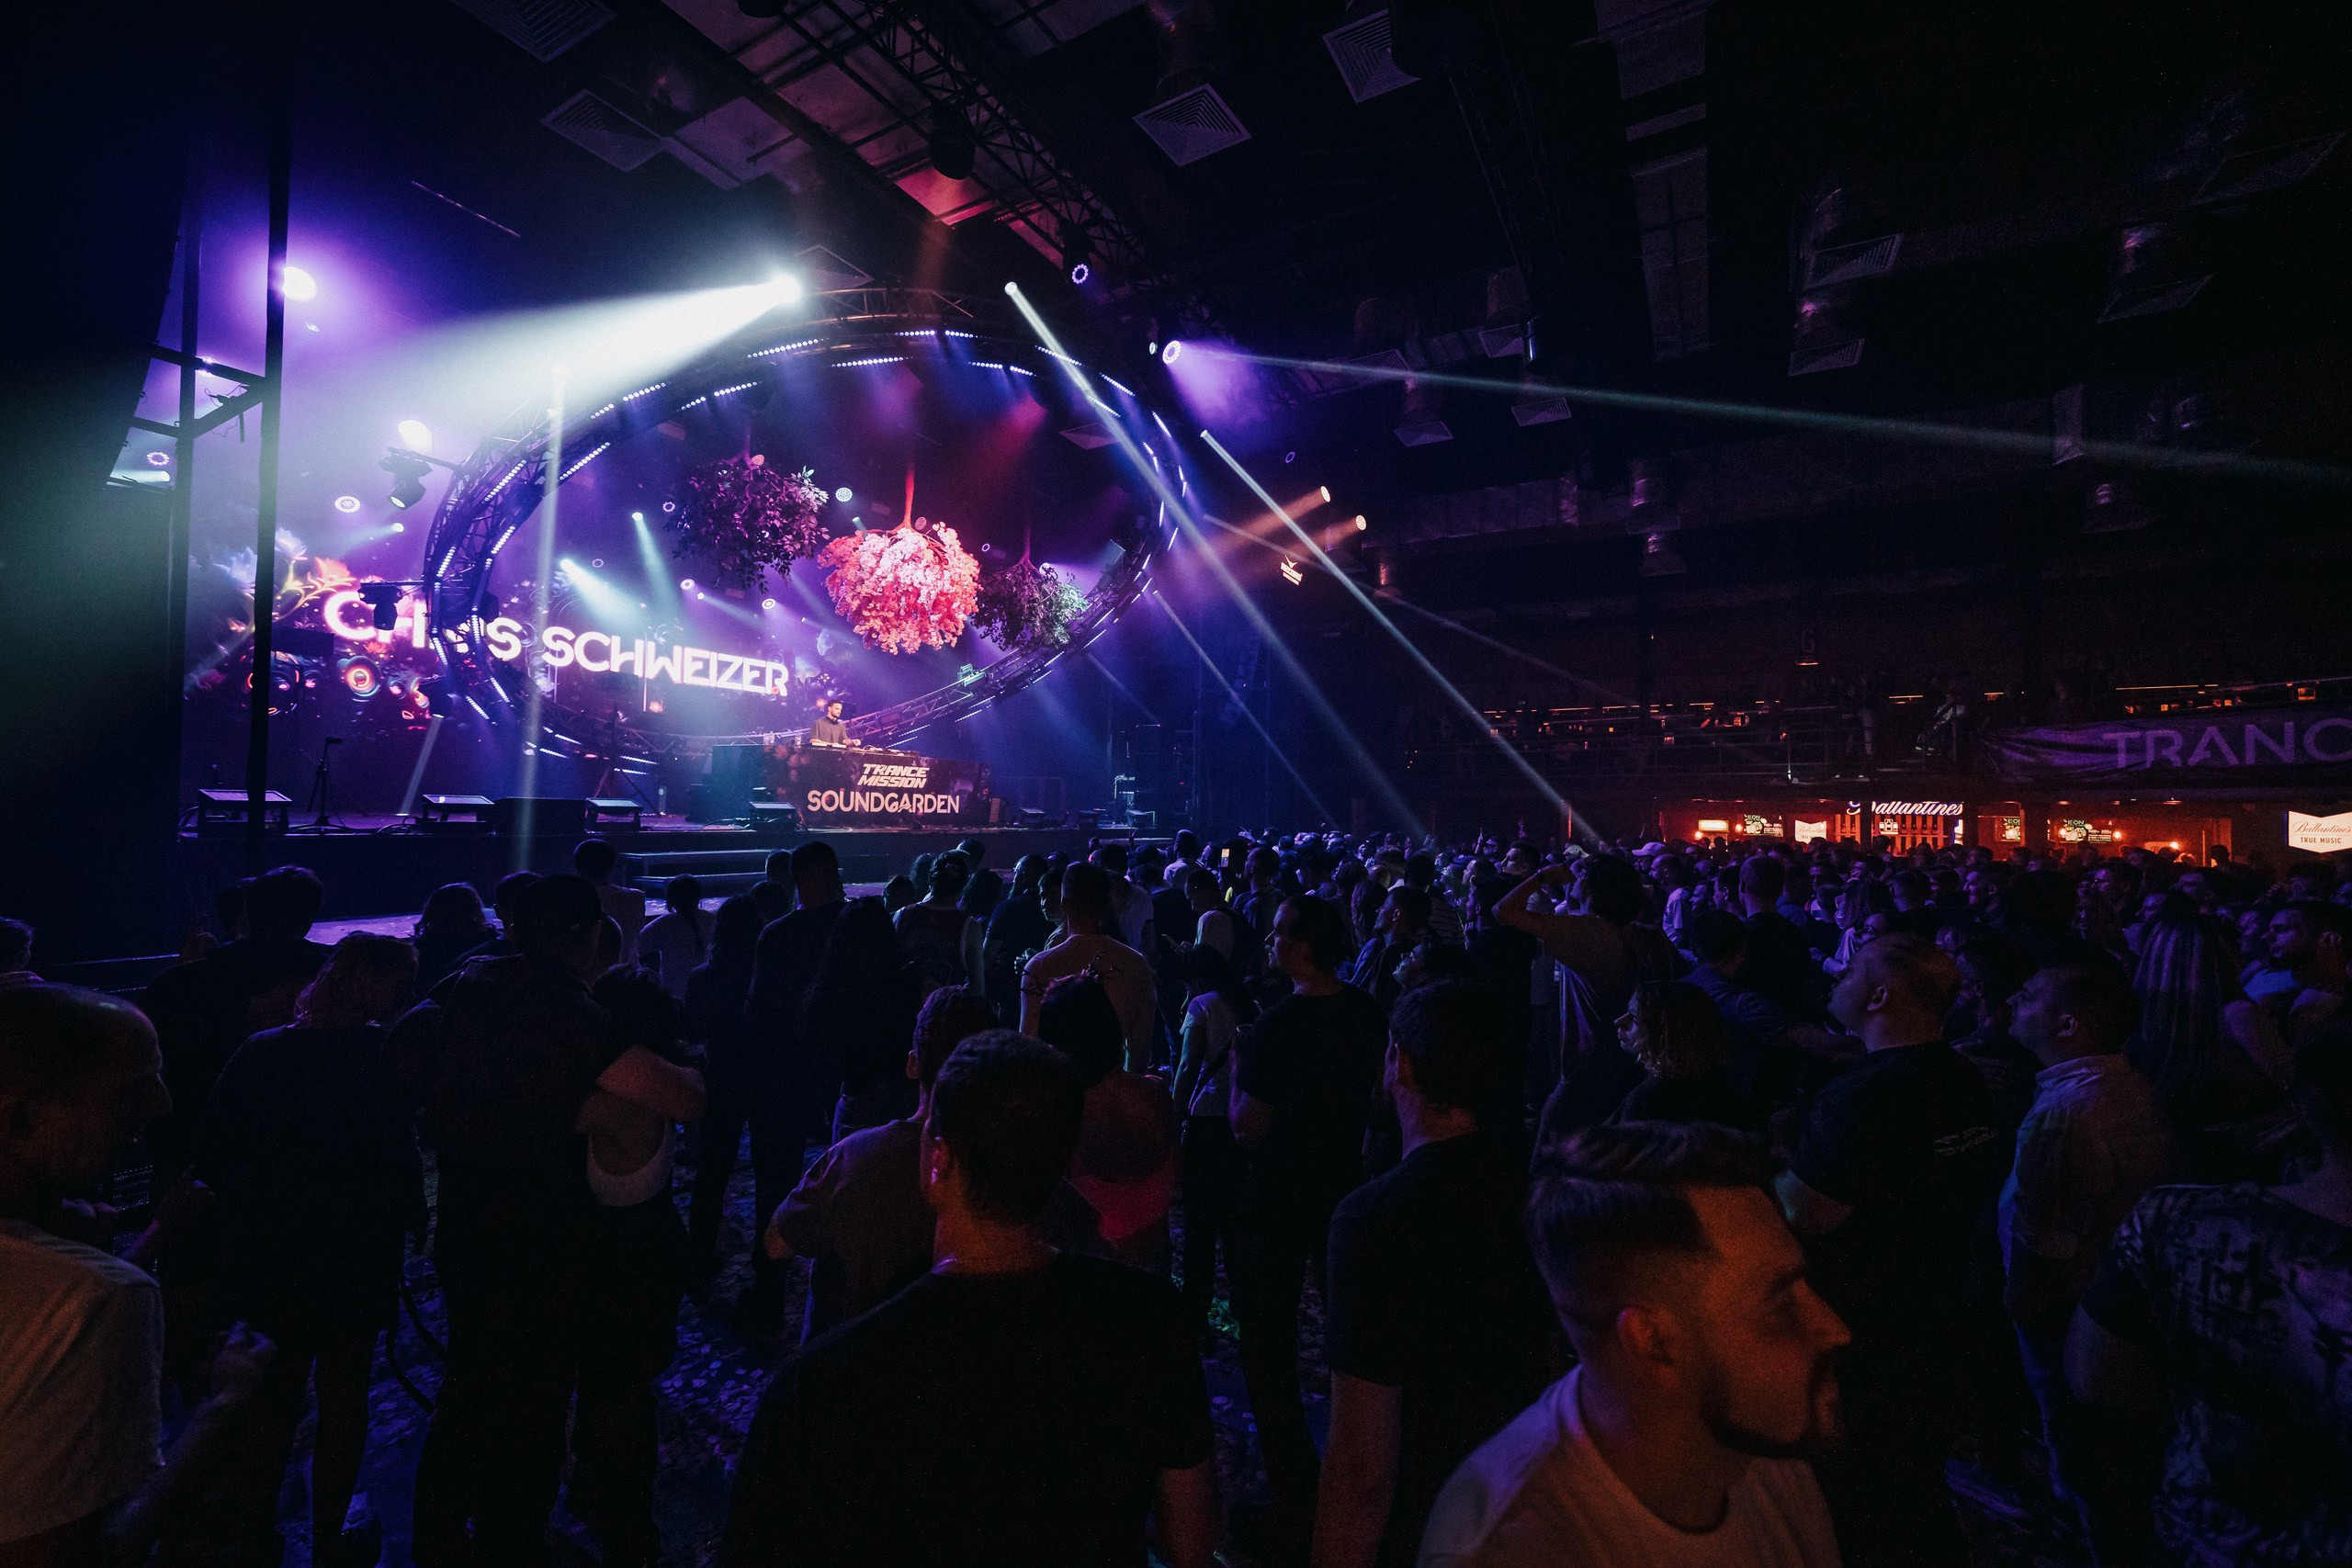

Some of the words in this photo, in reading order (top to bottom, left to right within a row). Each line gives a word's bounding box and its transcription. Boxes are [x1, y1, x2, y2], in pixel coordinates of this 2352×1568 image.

[324, 591, 523, 660] CHS
[541, 626, 789, 696] SCHWEIZER
[863, 763, 930, 778] TRANCE
[857, 775, 927, 788] MISSION
[807, 790, 960, 814] SOUNDGARDEN
